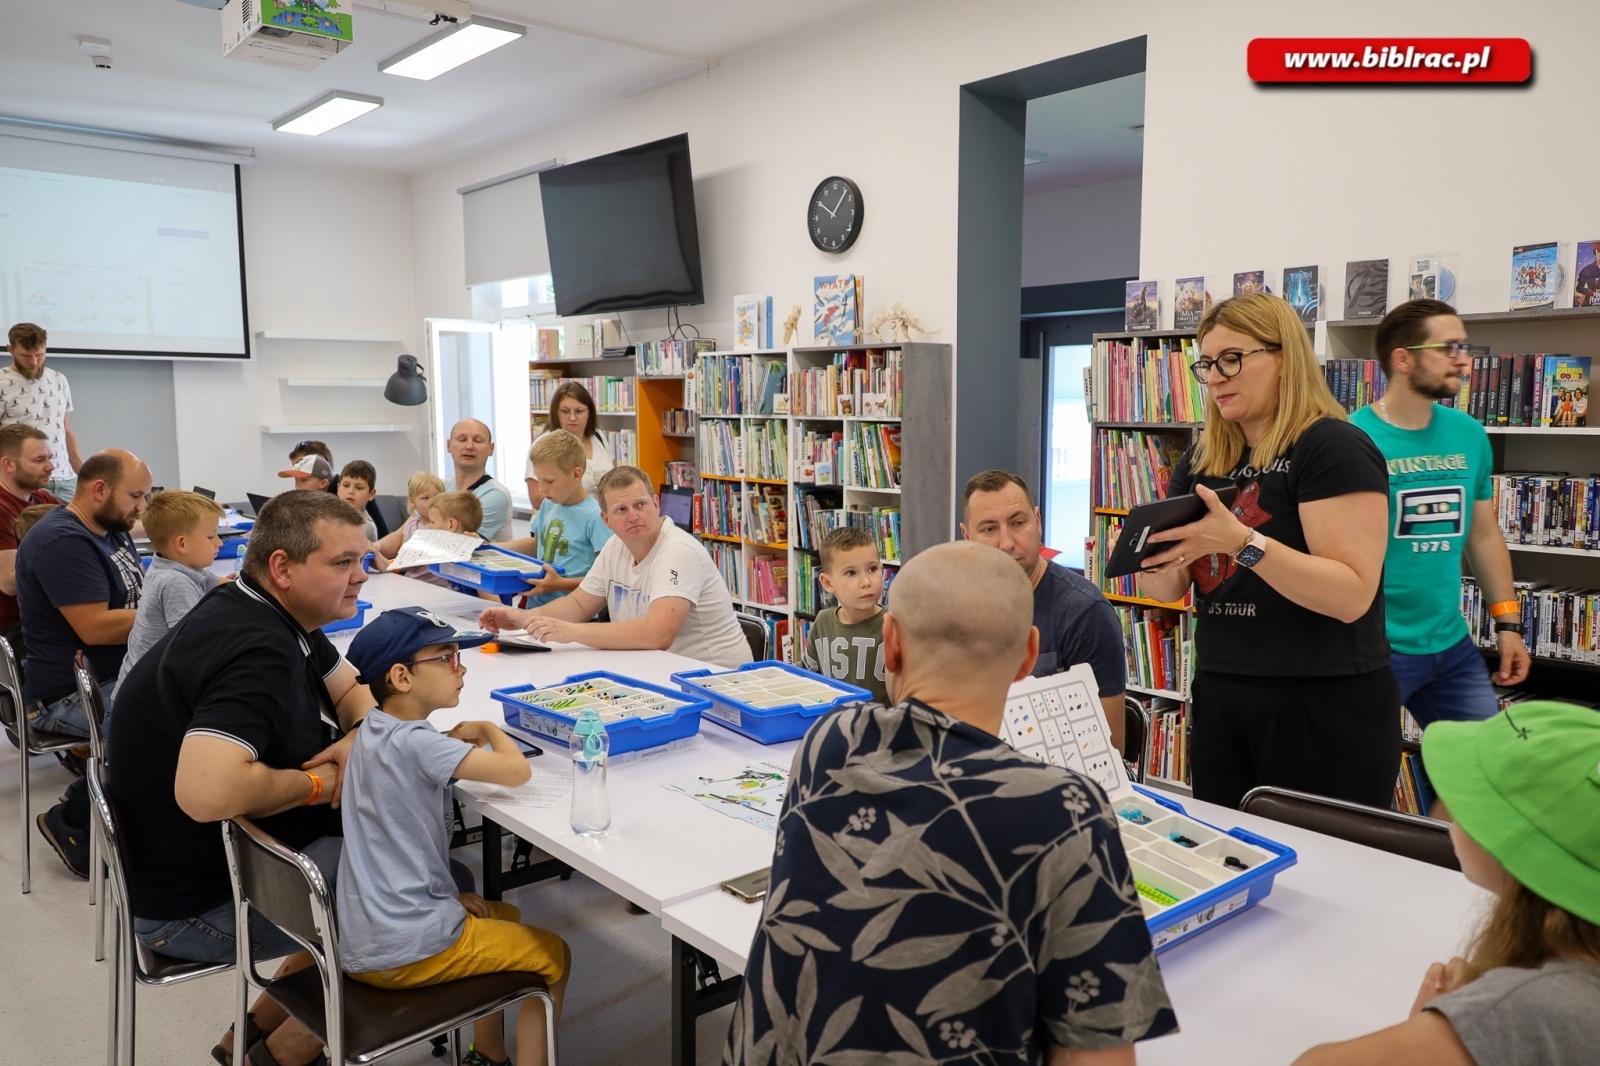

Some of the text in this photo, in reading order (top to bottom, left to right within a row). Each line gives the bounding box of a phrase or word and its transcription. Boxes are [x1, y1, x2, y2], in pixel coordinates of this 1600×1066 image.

[820, 280, 850, 290] WIATR
[1387, 454, 1468, 475] VINTAGE
[1411, 540, 1451, 553] 1978
[1224, 603, 1257, 617] TOUR
